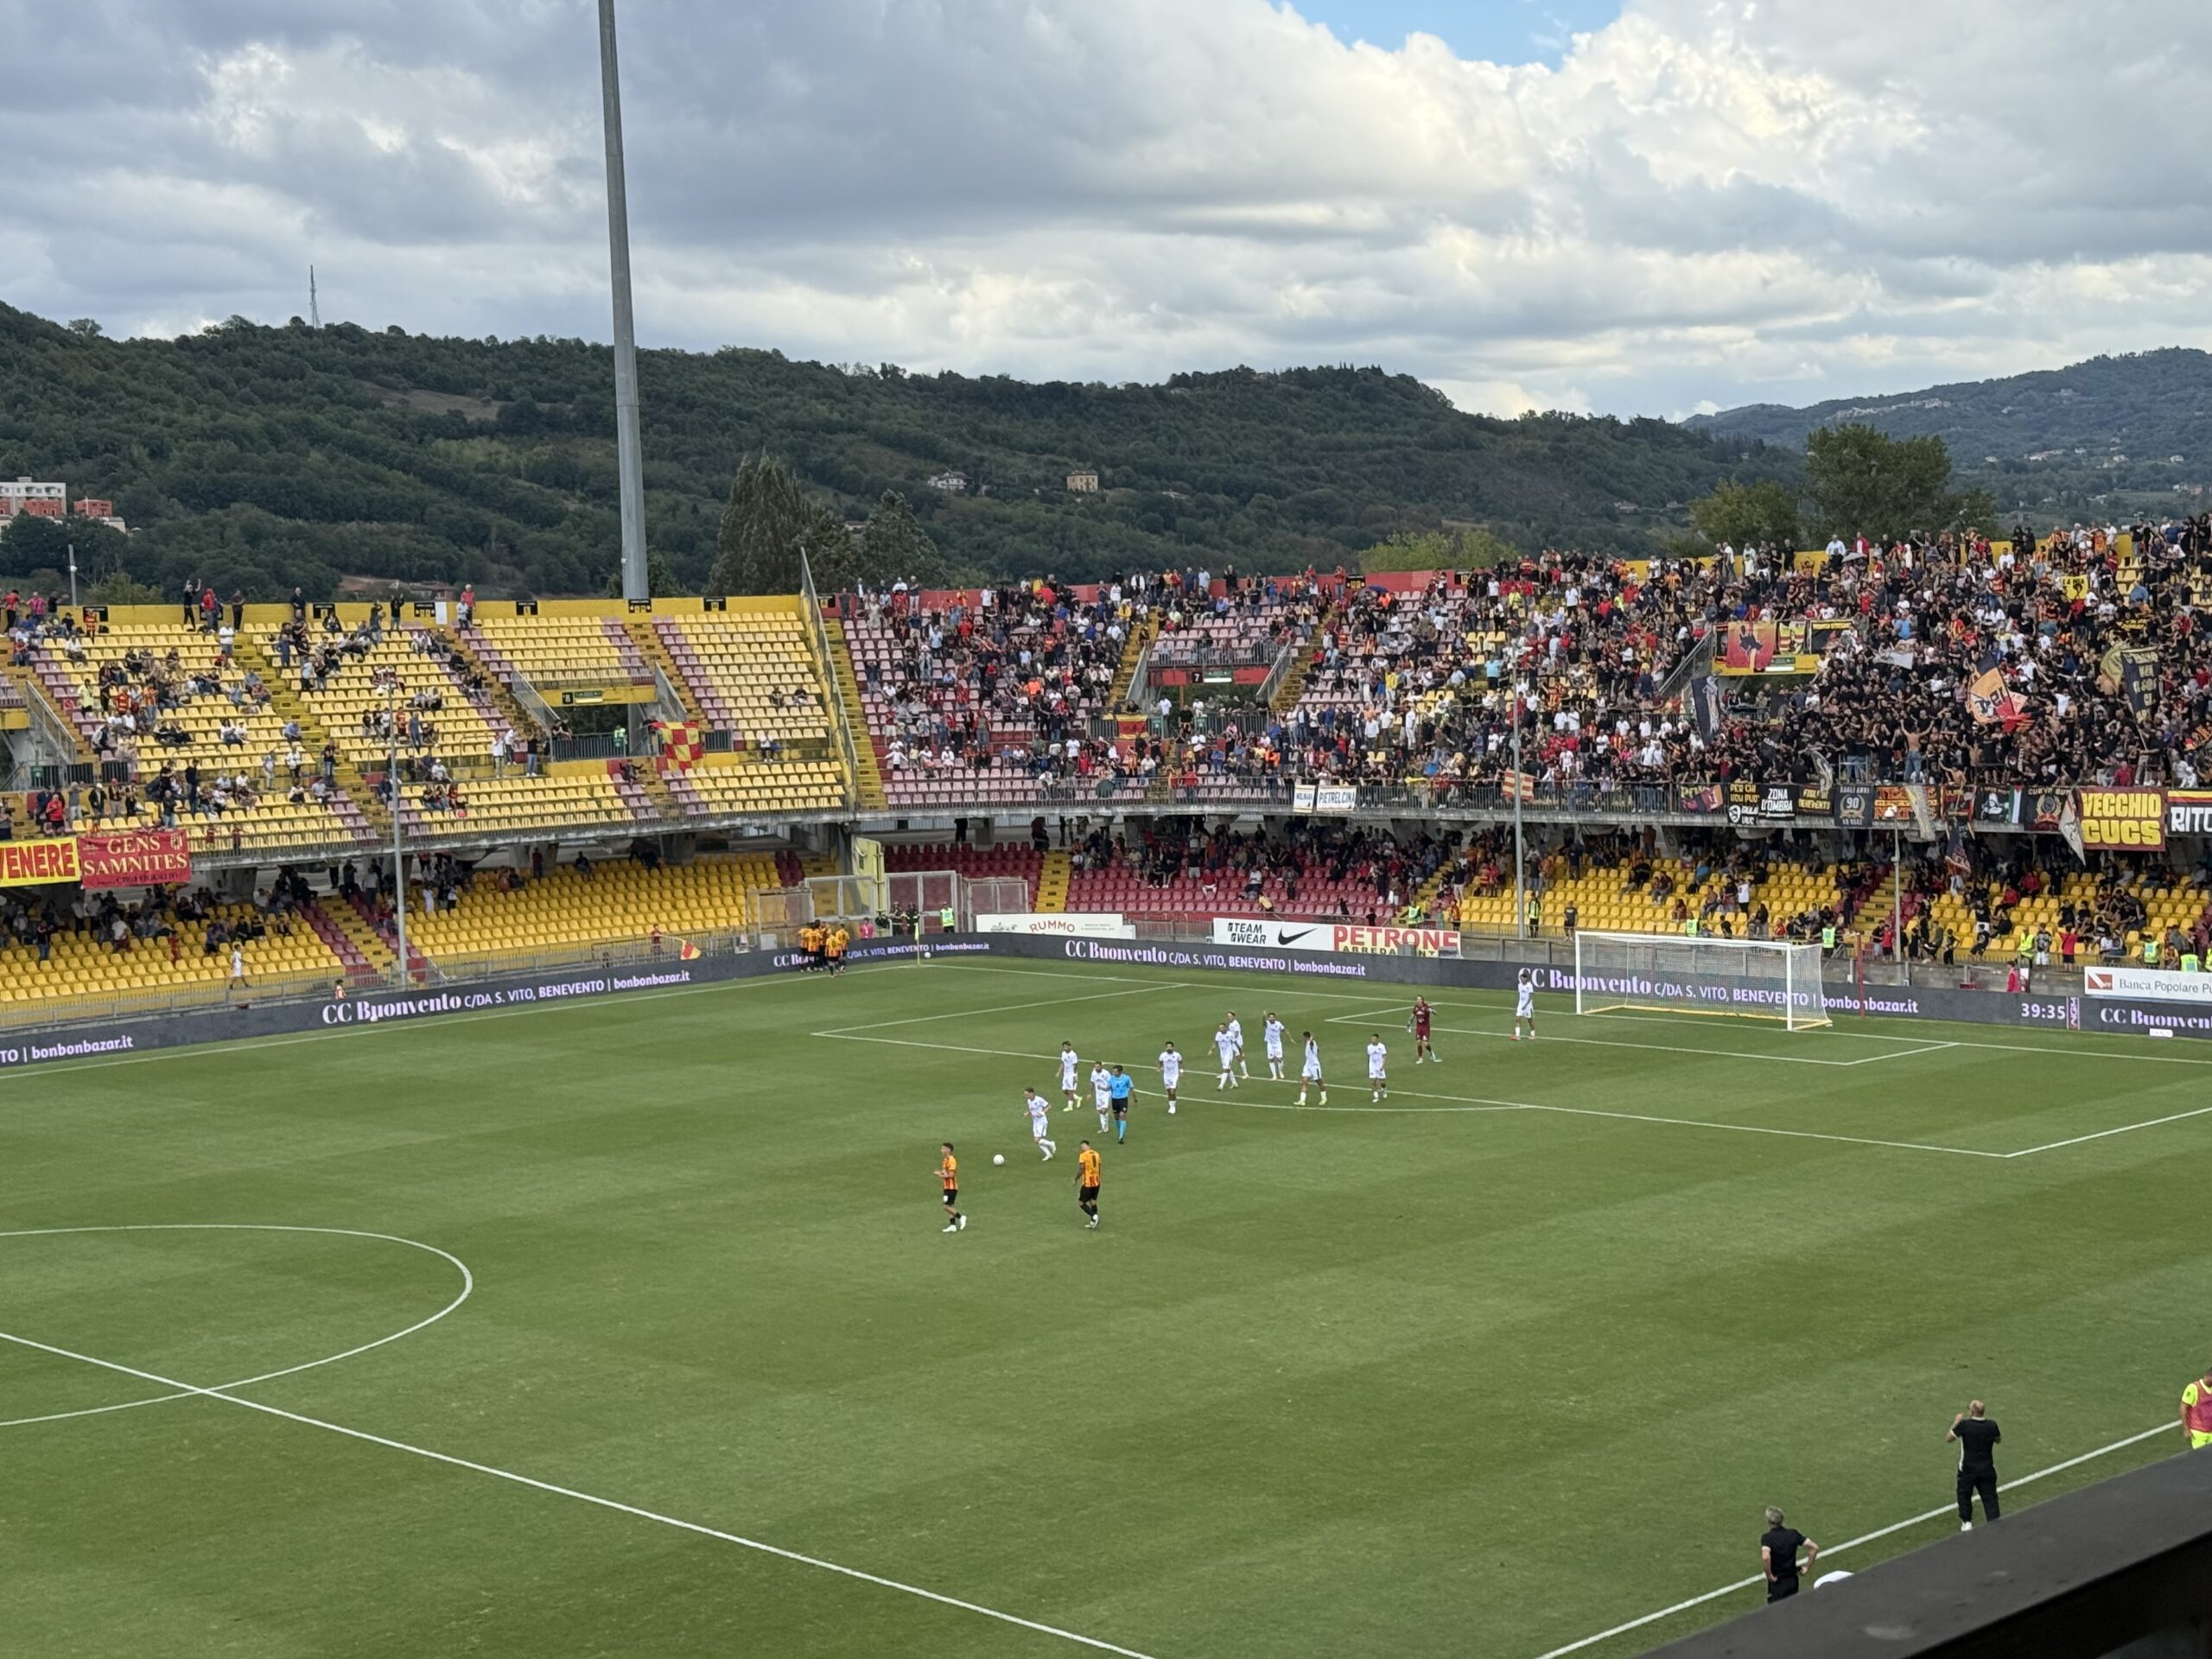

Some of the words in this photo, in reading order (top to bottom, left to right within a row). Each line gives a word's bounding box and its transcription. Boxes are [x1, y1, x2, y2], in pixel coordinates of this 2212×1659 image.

[1319, 791, 1355, 804] PIETRELCINA
[1768, 788, 1788, 800] ZONA
[1761, 799, 1793, 811] D'OMBRA
[1847, 798, 1859, 809] 90
[2081, 792, 2161, 817] VECCHIO
[2081, 819, 2161, 845] CUCS
[107, 836, 161, 855] GENS
[84, 852, 188, 876] SAMNITES
[1029, 920, 1076, 933] RUMMO
[1235, 923, 1262, 934] TEAM
[1237, 933, 1267, 944] WEAR
[1334, 926, 1458, 951] PETRONE
[887, 944, 929, 954] BENEVENTO
[936, 942, 989, 951] bonbonbazar.it
[773, 955, 790, 967] CC
[1065, 940, 1086, 958] CC
[1090, 942, 1166, 963] Buonvento
[1169, 952, 1191, 965] C/DA
[1193, 954, 1201, 965] S.
[1203, 955, 1226, 969] VITO,
[1229, 956, 1286, 970] BENEVENTO
[1294, 959, 1366, 976] bonbonbazar.it
[1518, 967, 1545, 988] CC
[1549, 969, 1651, 994] Buonvento
[1655, 983, 1683, 997] C/DA
[1686, 985, 1696, 999] S.
[1700, 987, 1730, 1001] VITO,
[1733, 988, 1808, 1006] BENEVENTO
[2120, 978, 2152, 990] Banca
[2155, 981, 2198, 994] Popolare
[321, 1003, 353, 1024] CC
[357, 994, 461, 1021] Buonvento
[464, 994, 493, 1008] C/DA
[495, 992, 505, 1005] S.
[507, 988, 537, 1001] VITO,
[538, 980, 605, 998] BENEVENTO
[613, 969, 690, 990] bonbonbazar.it
[2021, 1003, 2066, 1020] 39:35
[2101, 1007, 2126, 1024] CC
[2131, 1009, 2212, 1029] Buonven
[32, 1035, 134, 1059] bonbonbazar.it
